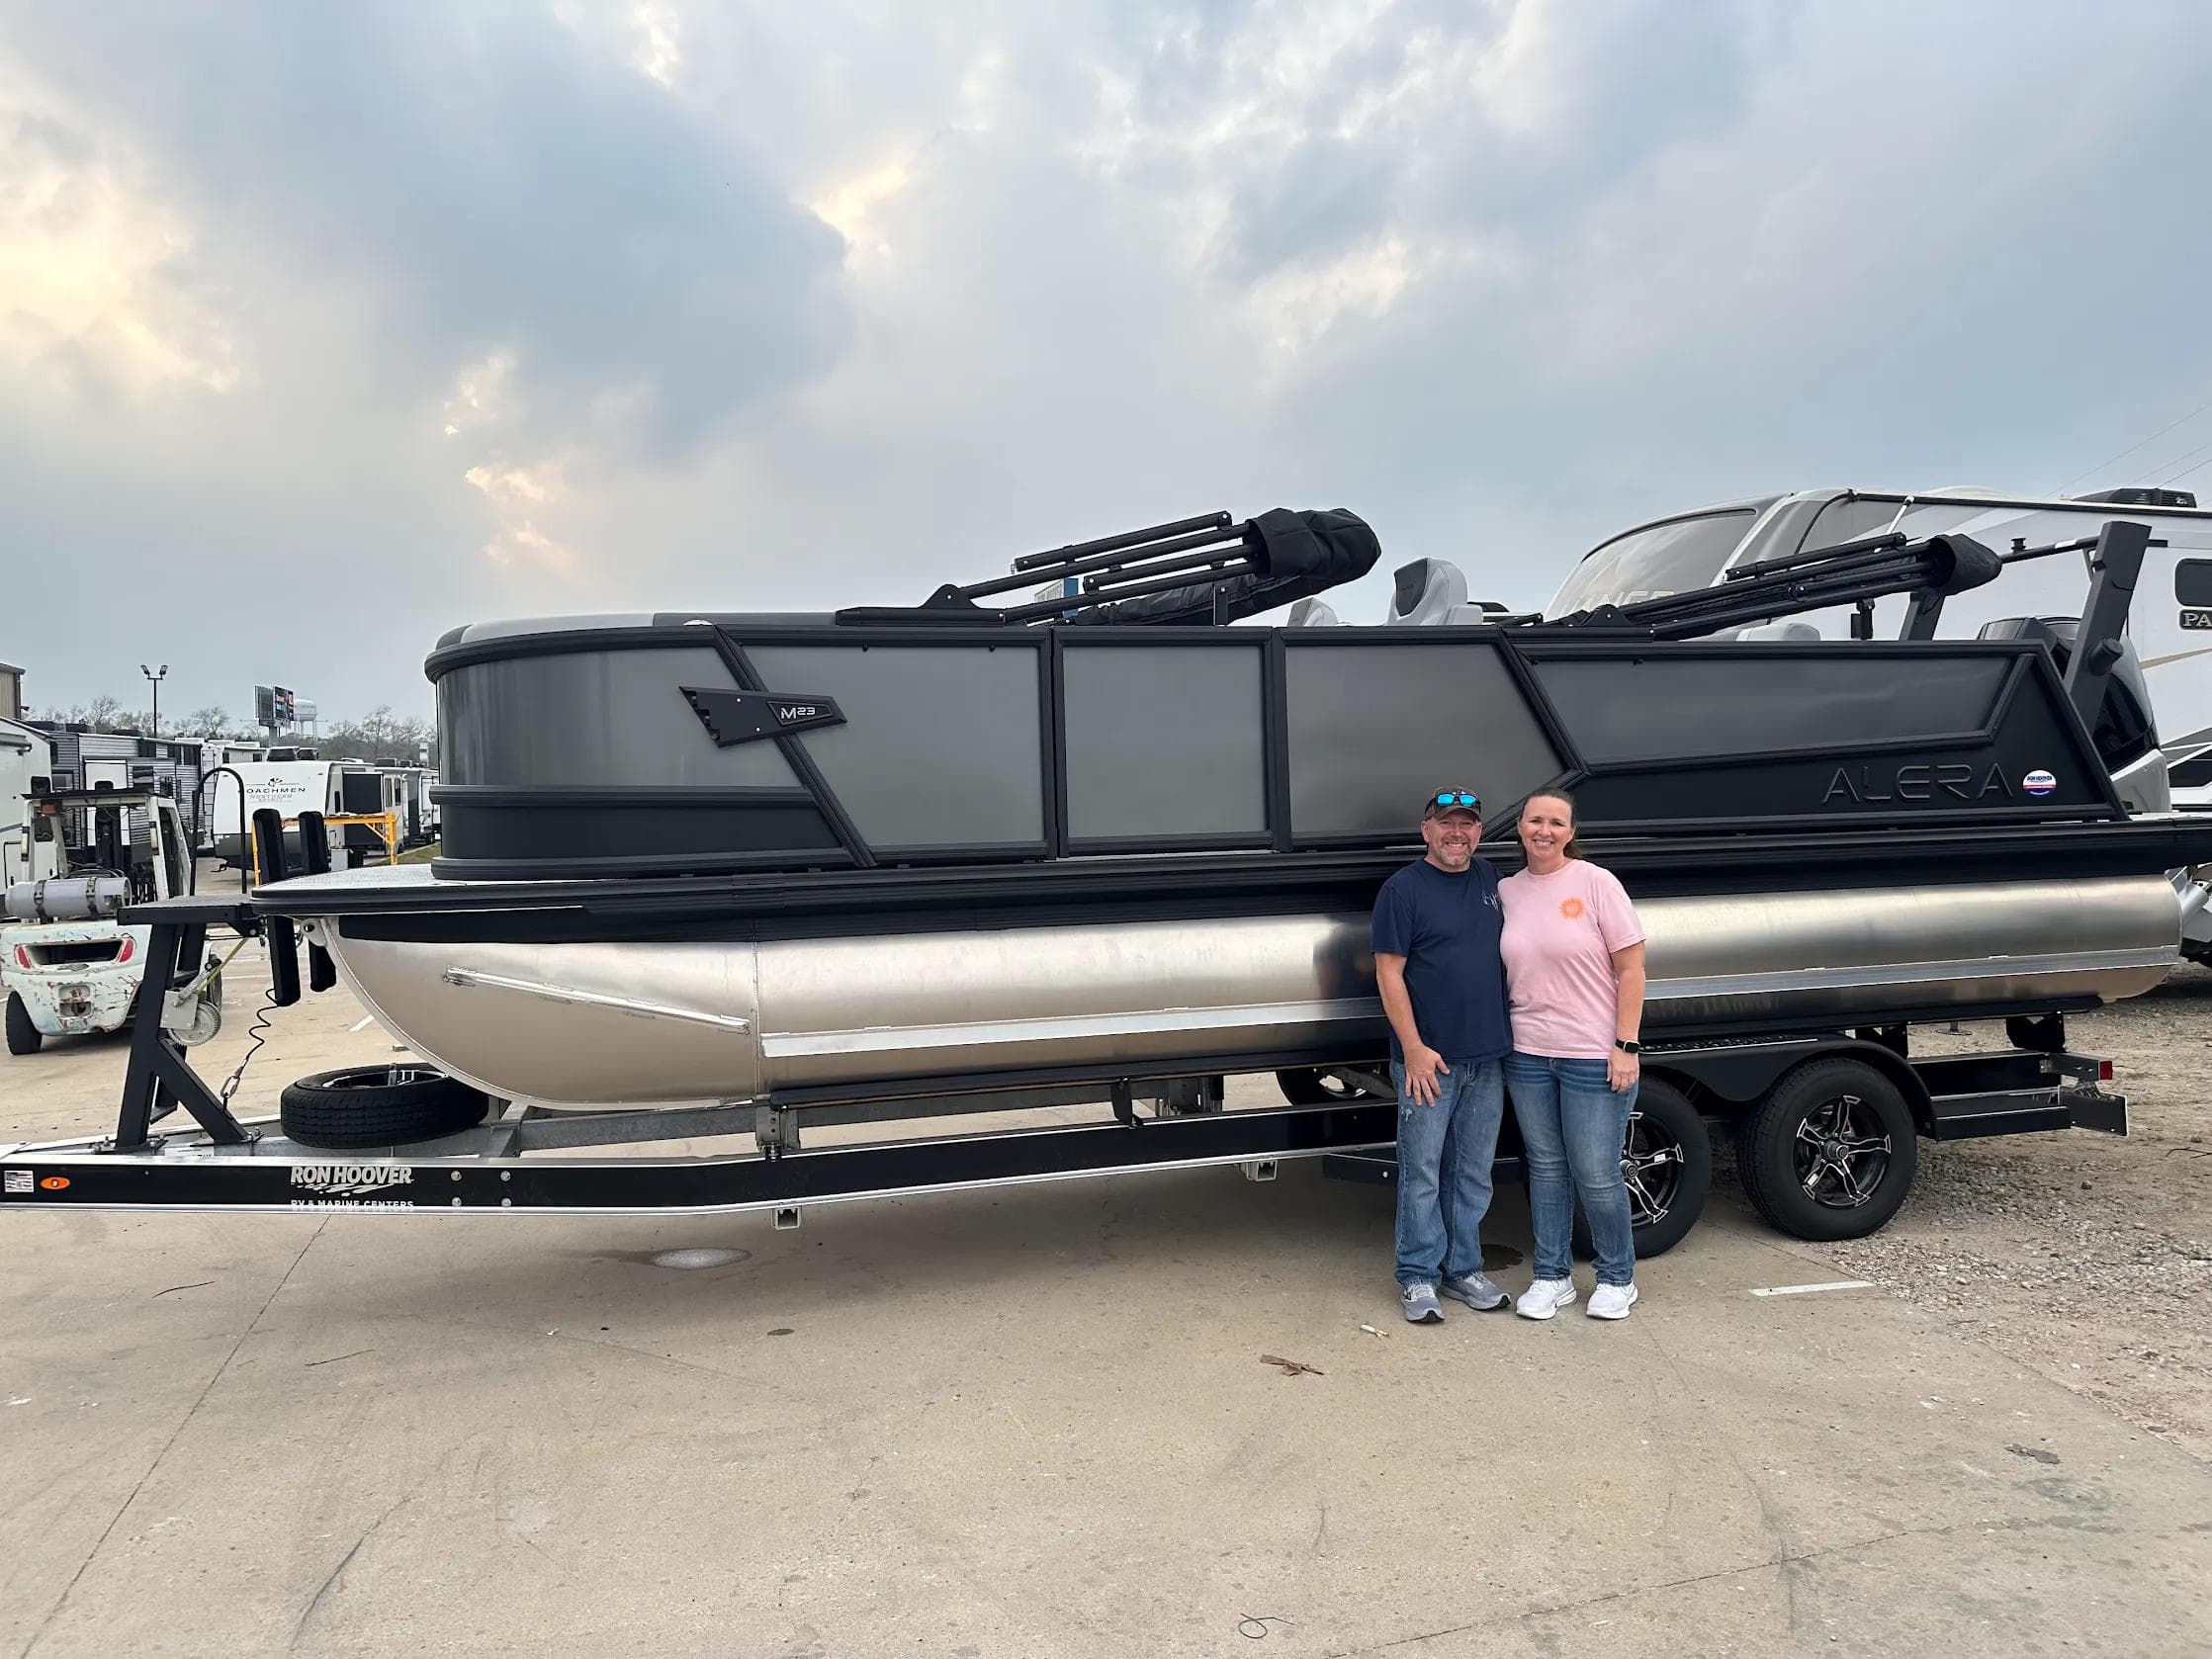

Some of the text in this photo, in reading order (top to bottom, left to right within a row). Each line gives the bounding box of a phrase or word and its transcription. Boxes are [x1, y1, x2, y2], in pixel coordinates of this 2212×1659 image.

[781, 707, 816, 719] M23
[1822, 762, 2014, 804] ALERA
[291, 1166, 412, 1184] RON HOOVER
